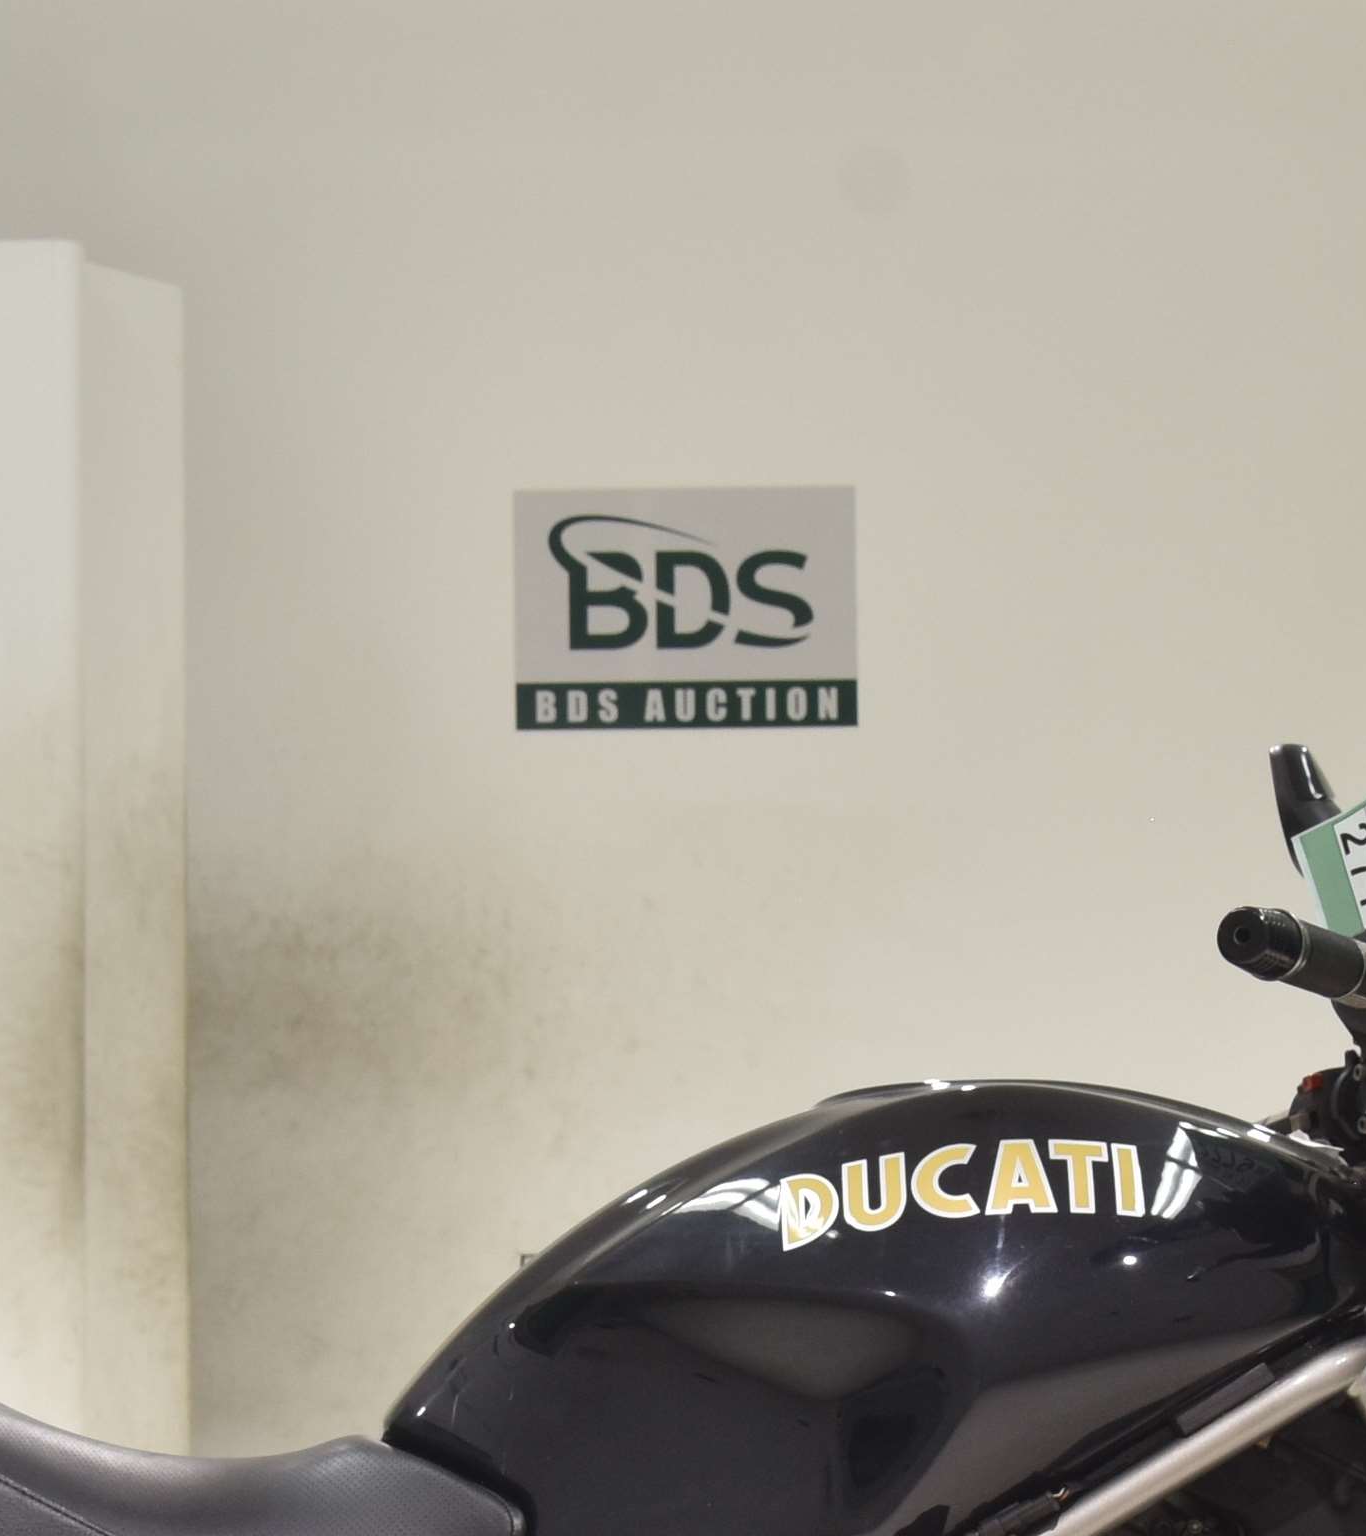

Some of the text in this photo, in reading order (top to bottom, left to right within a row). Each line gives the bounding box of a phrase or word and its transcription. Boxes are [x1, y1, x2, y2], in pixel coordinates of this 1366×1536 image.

[547, 515, 814, 651] BDS
[536, 686, 840, 724] BDS AUCTION
[778, 1138, 1146, 1251] DUCATI
